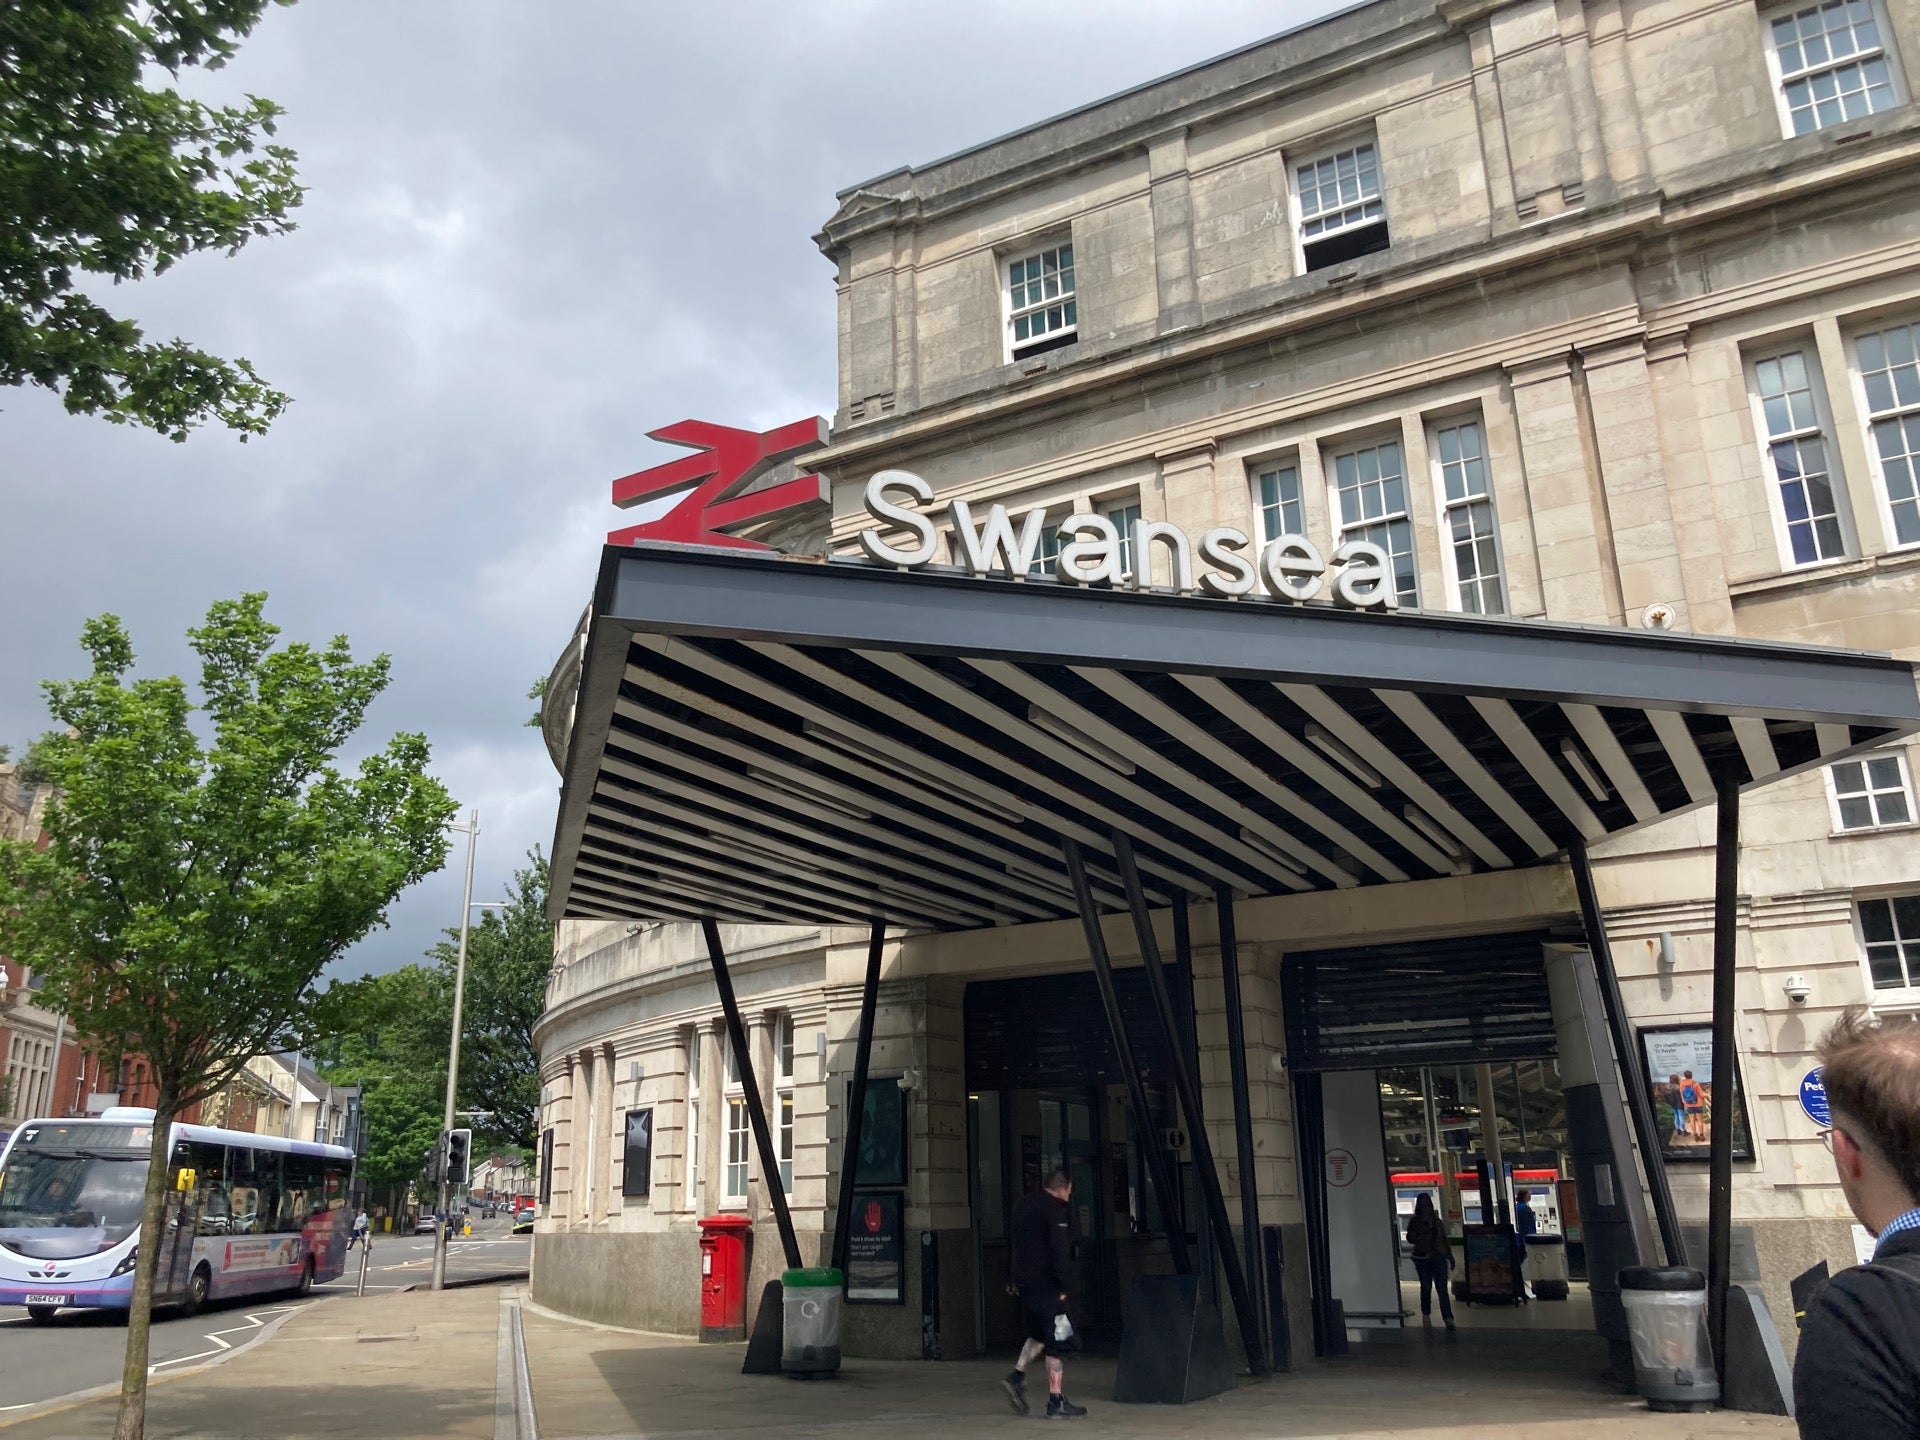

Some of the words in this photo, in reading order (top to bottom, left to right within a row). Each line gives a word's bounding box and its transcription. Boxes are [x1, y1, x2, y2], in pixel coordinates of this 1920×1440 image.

[858, 469, 1398, 611] Swansea
[1804, 1082, 1825, 1091] Pet
[28, 1295, 47, 1303] SN64
[48, 1295, 63, 1303] CFV
